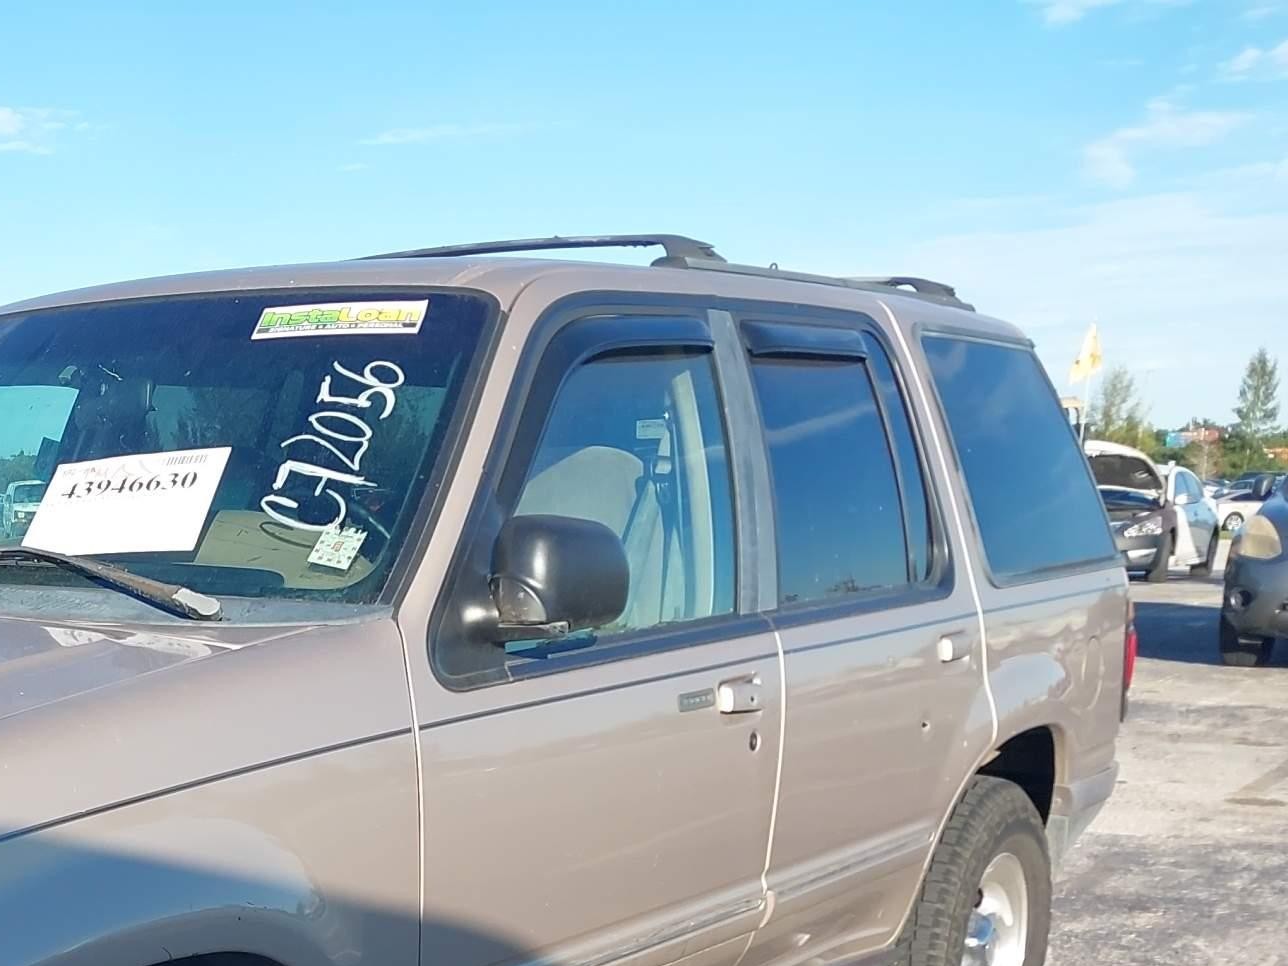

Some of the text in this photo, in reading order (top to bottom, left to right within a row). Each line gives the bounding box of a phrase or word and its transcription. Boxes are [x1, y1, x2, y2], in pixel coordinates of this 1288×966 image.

[260, 307, 421, 328] InstaLoan
[260, 360, 406, 533] C72056
[60, 471, 198, 499] 43946630
